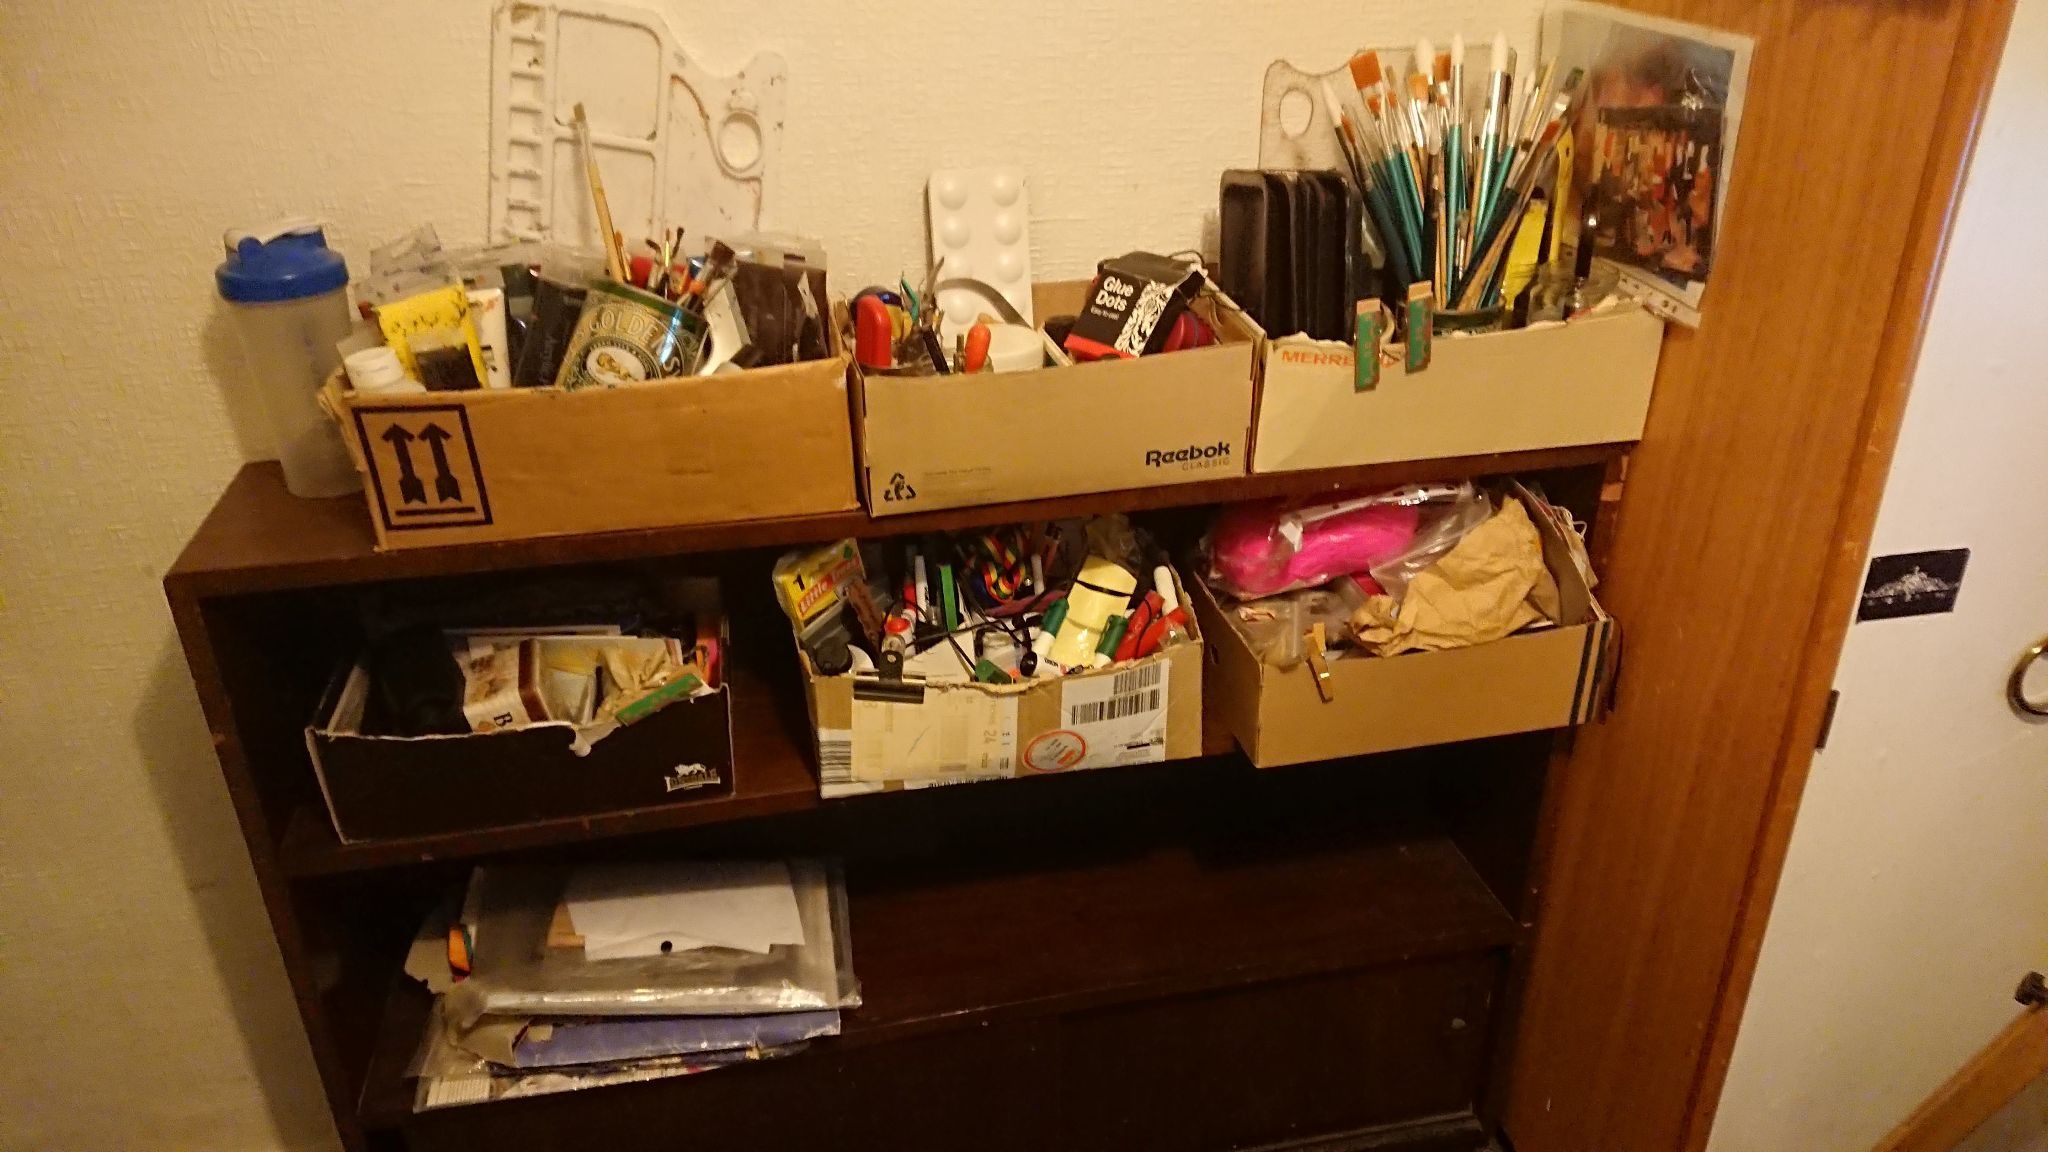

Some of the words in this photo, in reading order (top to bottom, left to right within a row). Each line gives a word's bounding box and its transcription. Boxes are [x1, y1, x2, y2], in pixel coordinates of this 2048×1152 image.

[1104, 276, 1133, 297] Glue
[1096, 290, 1127, 311] Dots
[1281, 350, 1356, 367] MERRE
[1145, 441, 1230, 468] Reebok
[793, 574, 806, 591] 1
